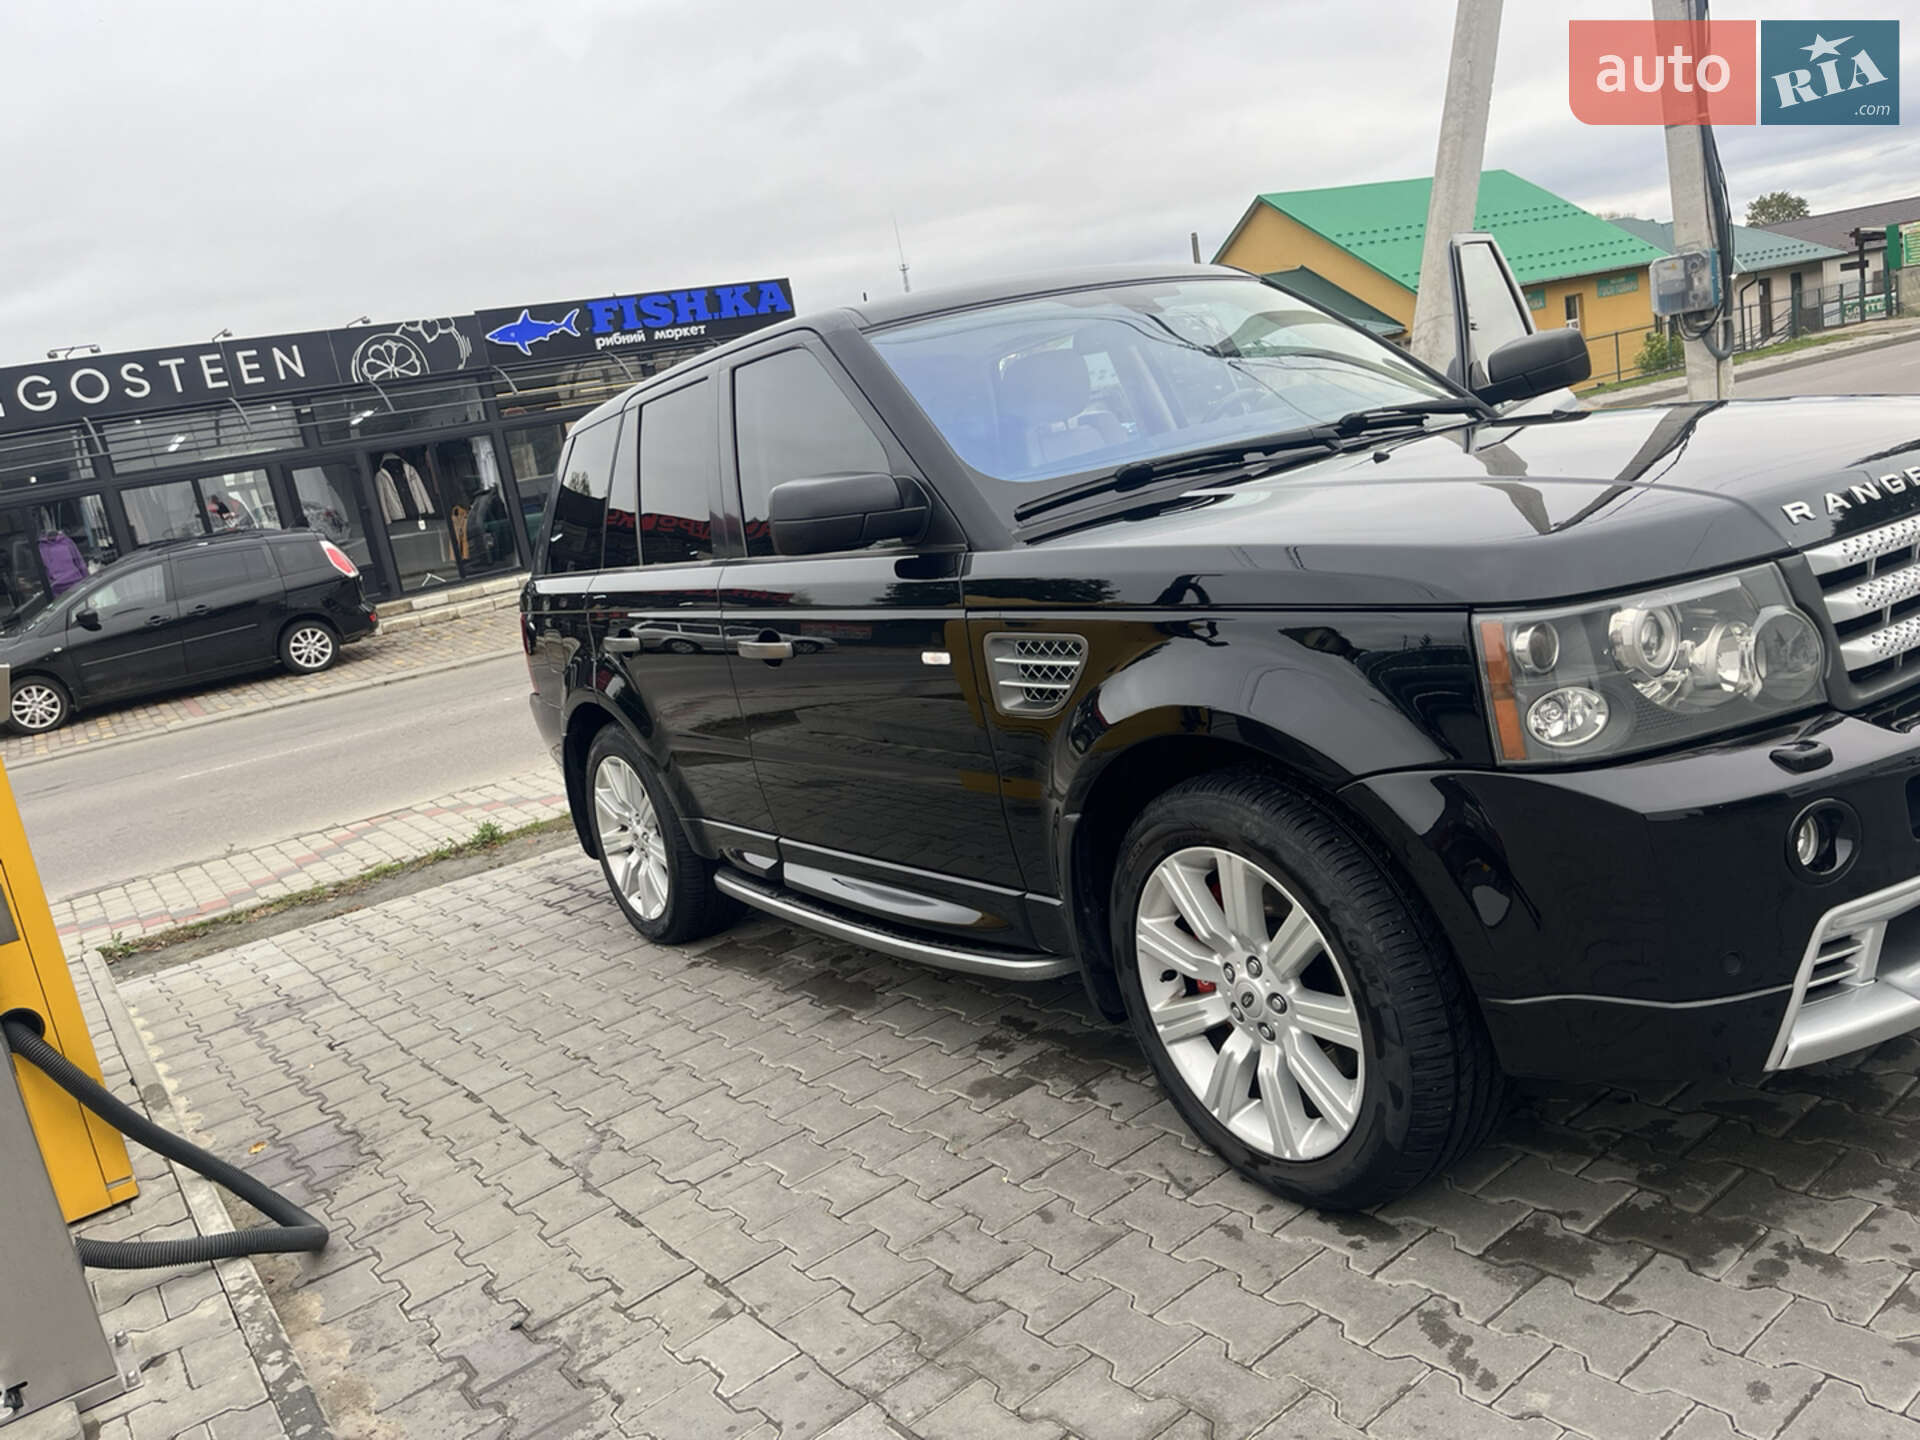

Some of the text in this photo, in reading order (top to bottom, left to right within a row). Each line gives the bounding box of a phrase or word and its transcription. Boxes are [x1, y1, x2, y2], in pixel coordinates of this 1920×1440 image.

[594, 324, 706, 350] рибний маркет
[0, 344, 306, 417] GOSTEEN
